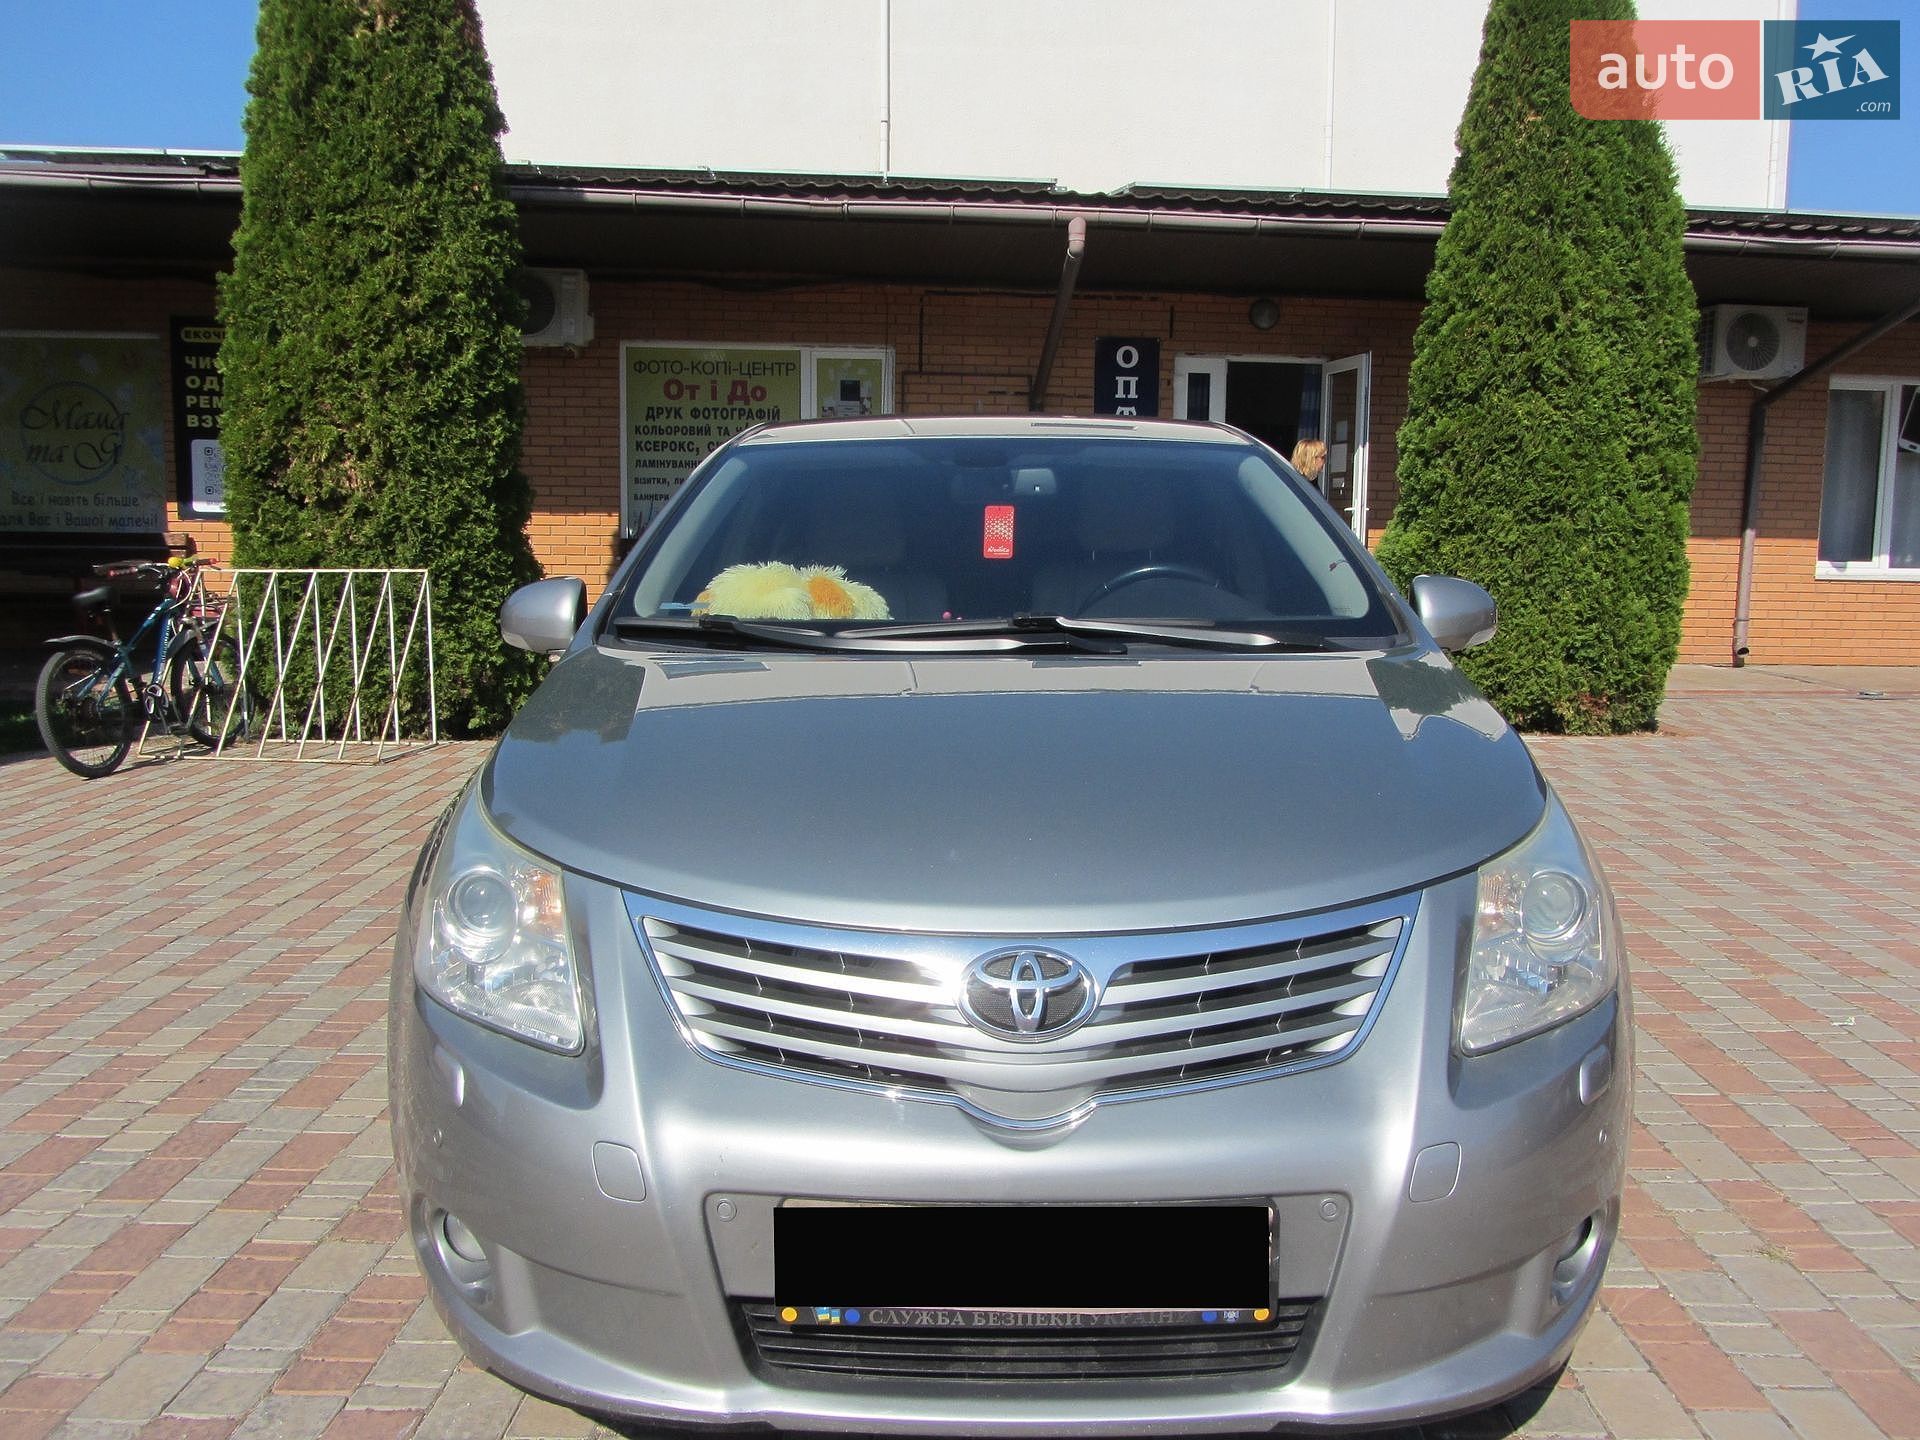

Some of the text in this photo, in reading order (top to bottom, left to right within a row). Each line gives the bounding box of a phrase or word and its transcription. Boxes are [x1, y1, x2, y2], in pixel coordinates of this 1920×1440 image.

[184, 355, 217, 370] ЧИ
[185, 376, 225, 392] ОД
[663, 378, 699, 401] От
[727, 380, 767, 406] До
[645, 406, 780, 421] ДРУК ФОТОГРАФІЙ
[634, 424, 711, 436] КОЛЬОРОВИЙ
[717, 426, 730, 436] ТА
[635, 441, 699, 456] КСЕРОКС,
[93, 492, 139, 507] більше
[868, 1308, 966, 1326] СЛУЖБА
[972, 1311, 1082, 1327] БЕЗПЕКИ
